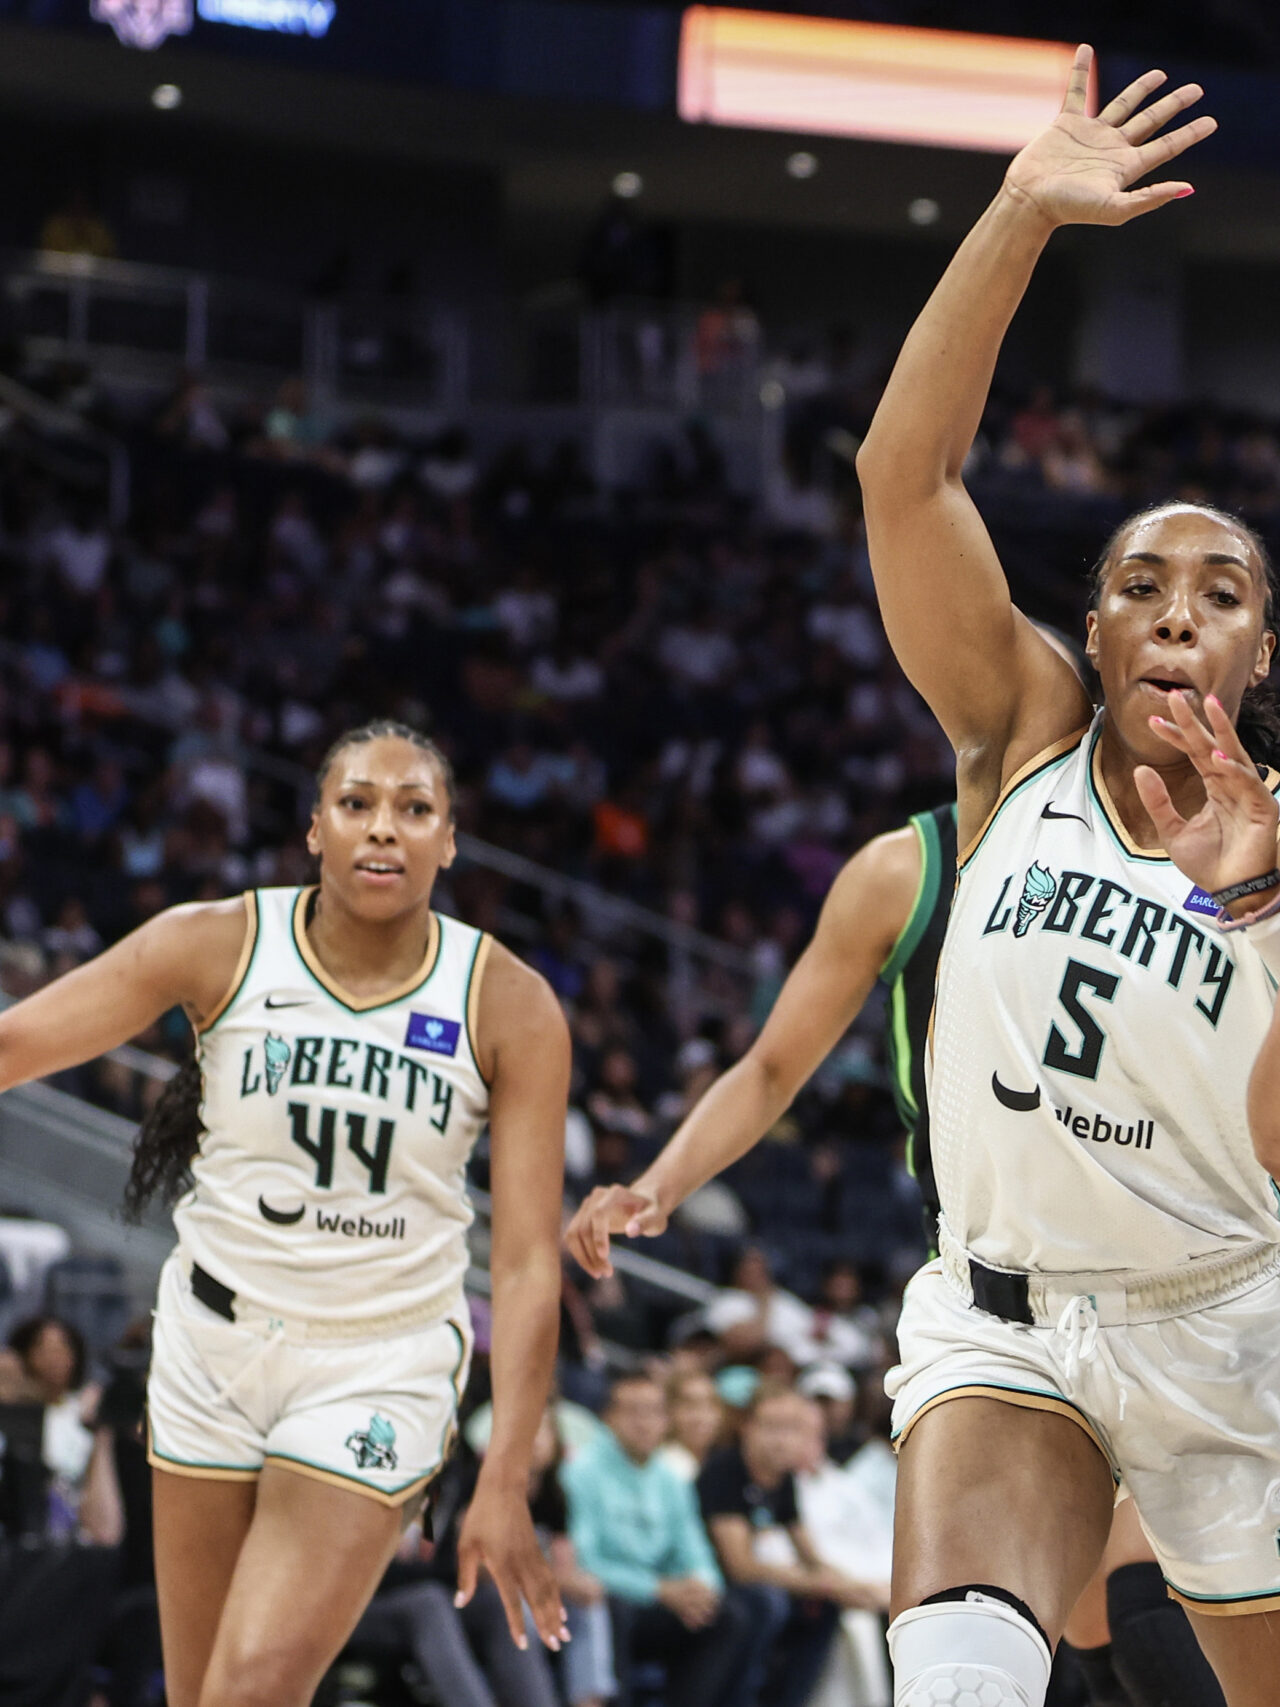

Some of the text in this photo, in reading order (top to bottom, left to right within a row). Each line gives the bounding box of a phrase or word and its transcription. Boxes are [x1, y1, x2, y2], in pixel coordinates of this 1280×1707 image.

[1042, 956, 1122, 1082] 5
[287, 1101, 396, 1195] 44
[316, 1207, 406, 1241] Webull
